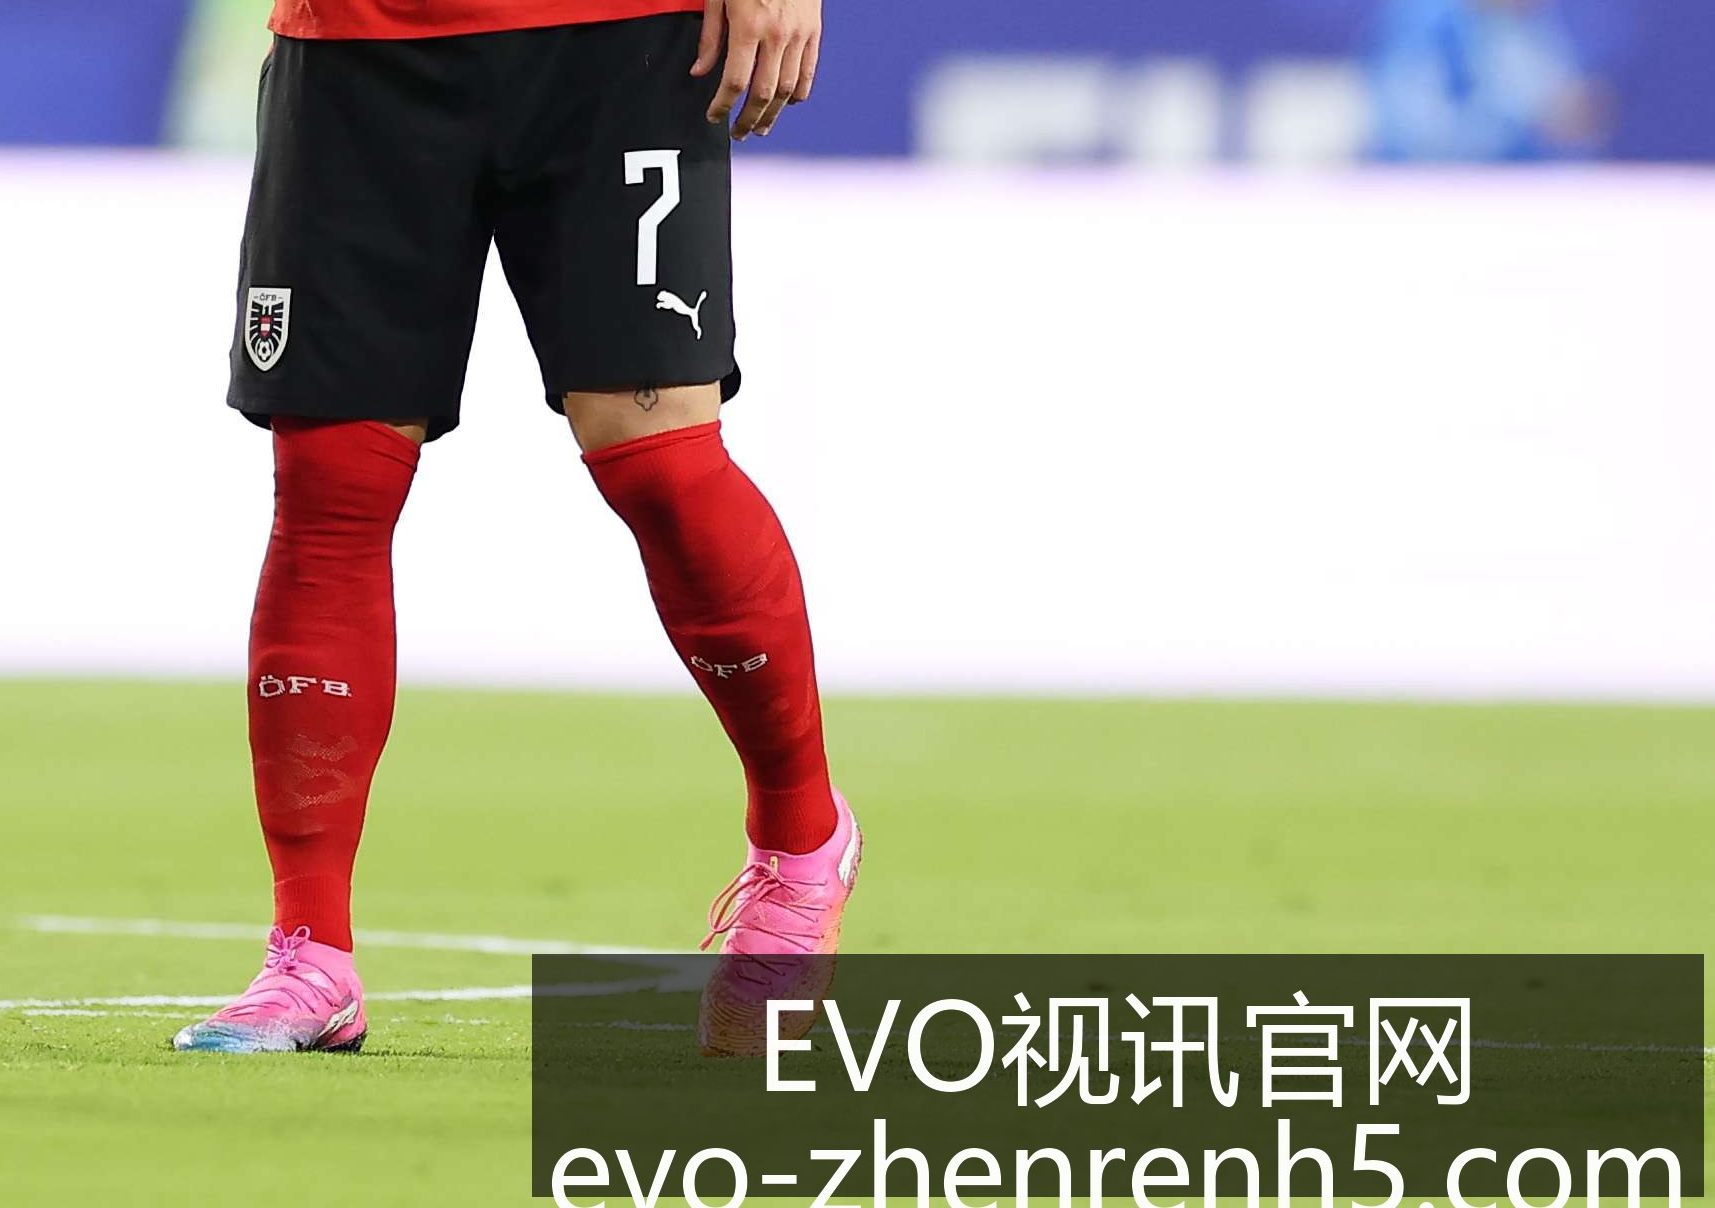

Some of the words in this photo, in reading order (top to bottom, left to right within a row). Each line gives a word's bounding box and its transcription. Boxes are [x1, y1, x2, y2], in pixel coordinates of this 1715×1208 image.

[624, 149, 681, 285] 7
[690, 652, 768, 678] ÖFB
[258, 674, 350, 698] ÖFB
